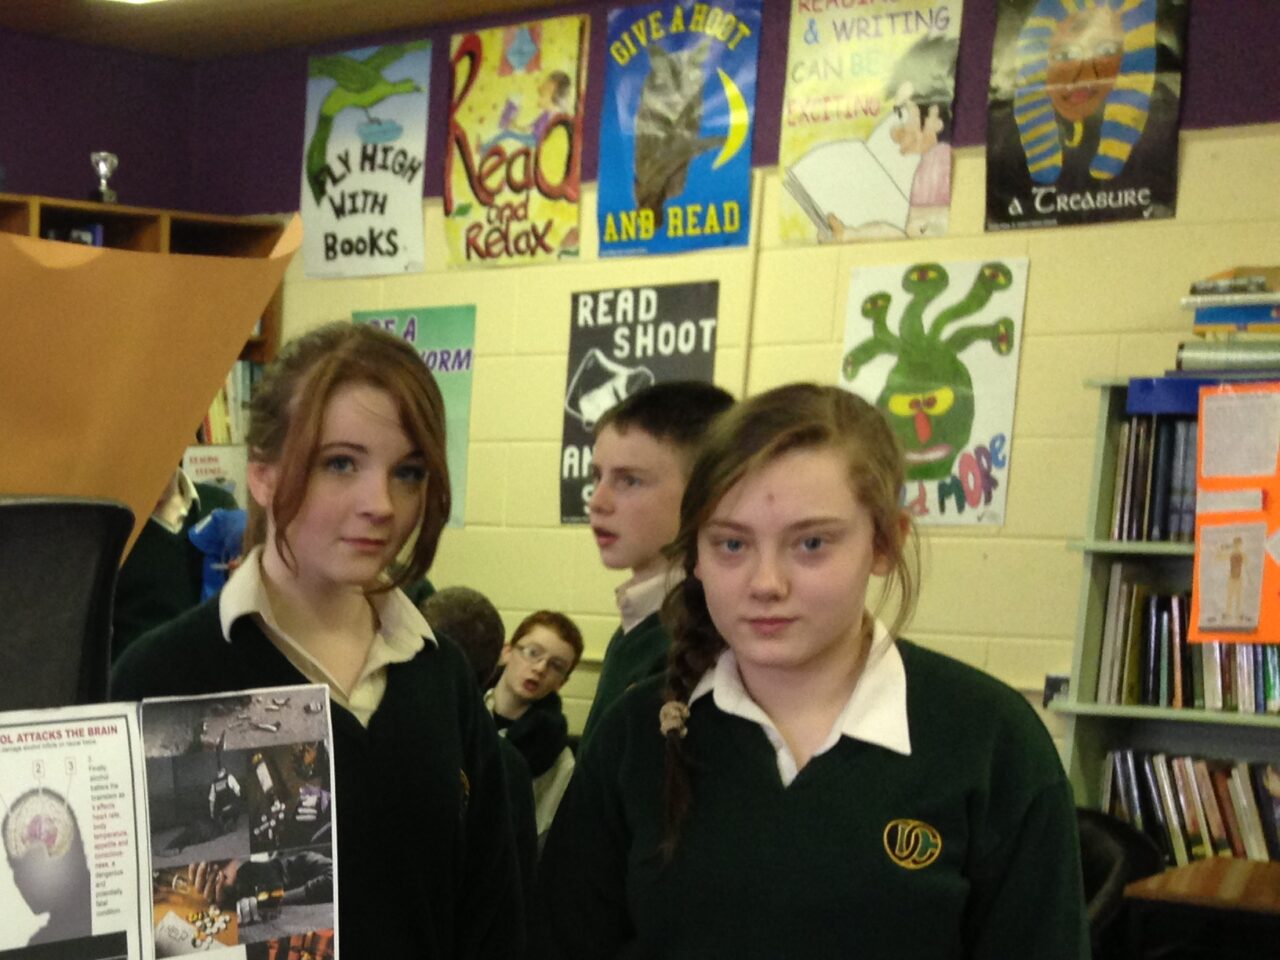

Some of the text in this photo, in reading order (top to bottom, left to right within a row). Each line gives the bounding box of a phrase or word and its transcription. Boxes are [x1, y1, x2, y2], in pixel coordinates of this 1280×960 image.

[610, 2, 752, 66] GIVE A HOOT
[832, 6, 950, 43] WRITING
[792, 55, 843, 84] CAN
[360, 144, 423, 184] HIGH
[328, 189, 387, 220] WITH
[667, 200, 741, 238] READ
[578, 288, 657, 328] READ
[613, 317, 716, 359] SHOOT
[17, 730, 62, 745] ATTACKS
[66, 728, 84, 740] THE
[87, 725, 118, 738] BRAIN
